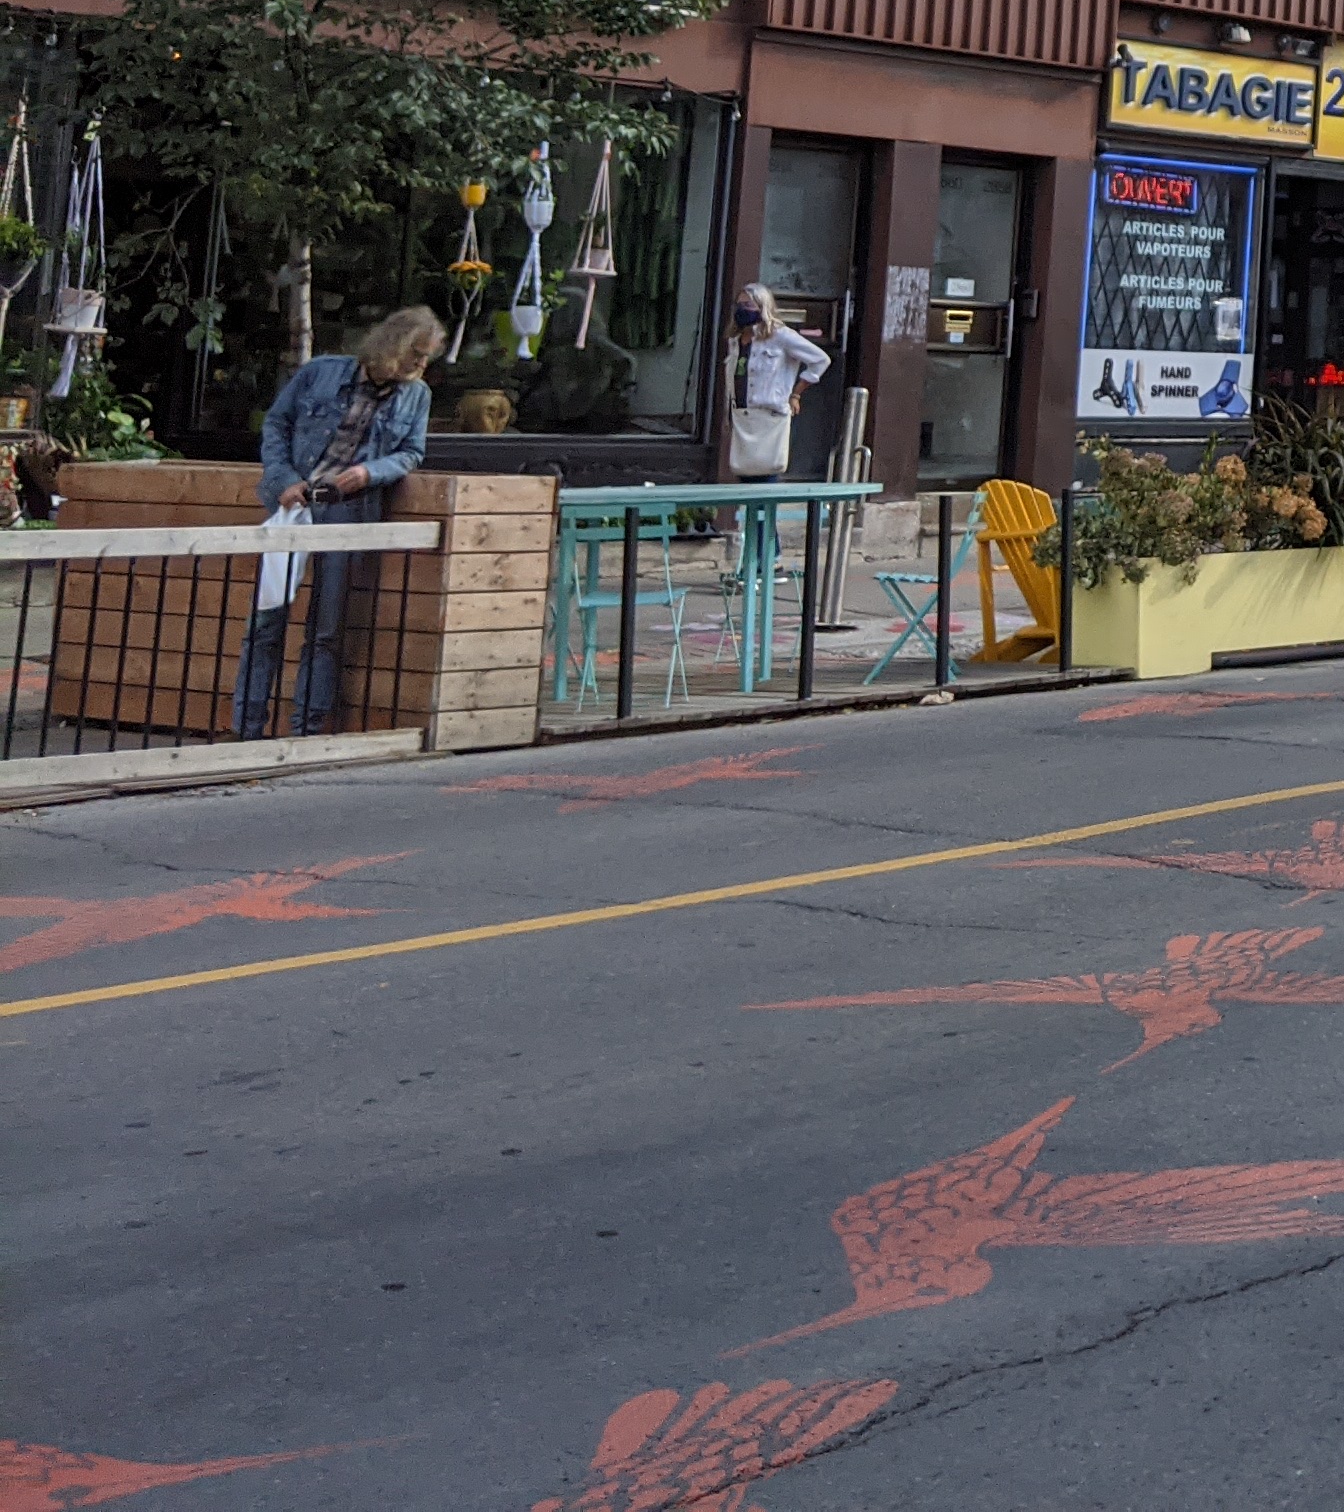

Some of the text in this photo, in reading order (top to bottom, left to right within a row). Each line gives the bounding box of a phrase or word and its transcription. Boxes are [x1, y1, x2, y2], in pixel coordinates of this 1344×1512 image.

[1119, 59, 1315, 125] TABAGIE
[1267, 125, 1309, 137] MASSON
[1112, 172, 1192, 206] OUVERT
[1122, 220, 1226, 241] ARTICLES POUR
[1136, 240, 1212, 259] VAPOTEURS
[1119, 273, 1225, 293] ARTICLES POUR
[1138, 295, 1203, 311] FUMEURS
[1160, 365, 1192, 379] HAND
[1150, 385, 1200, 399] SPINNER
